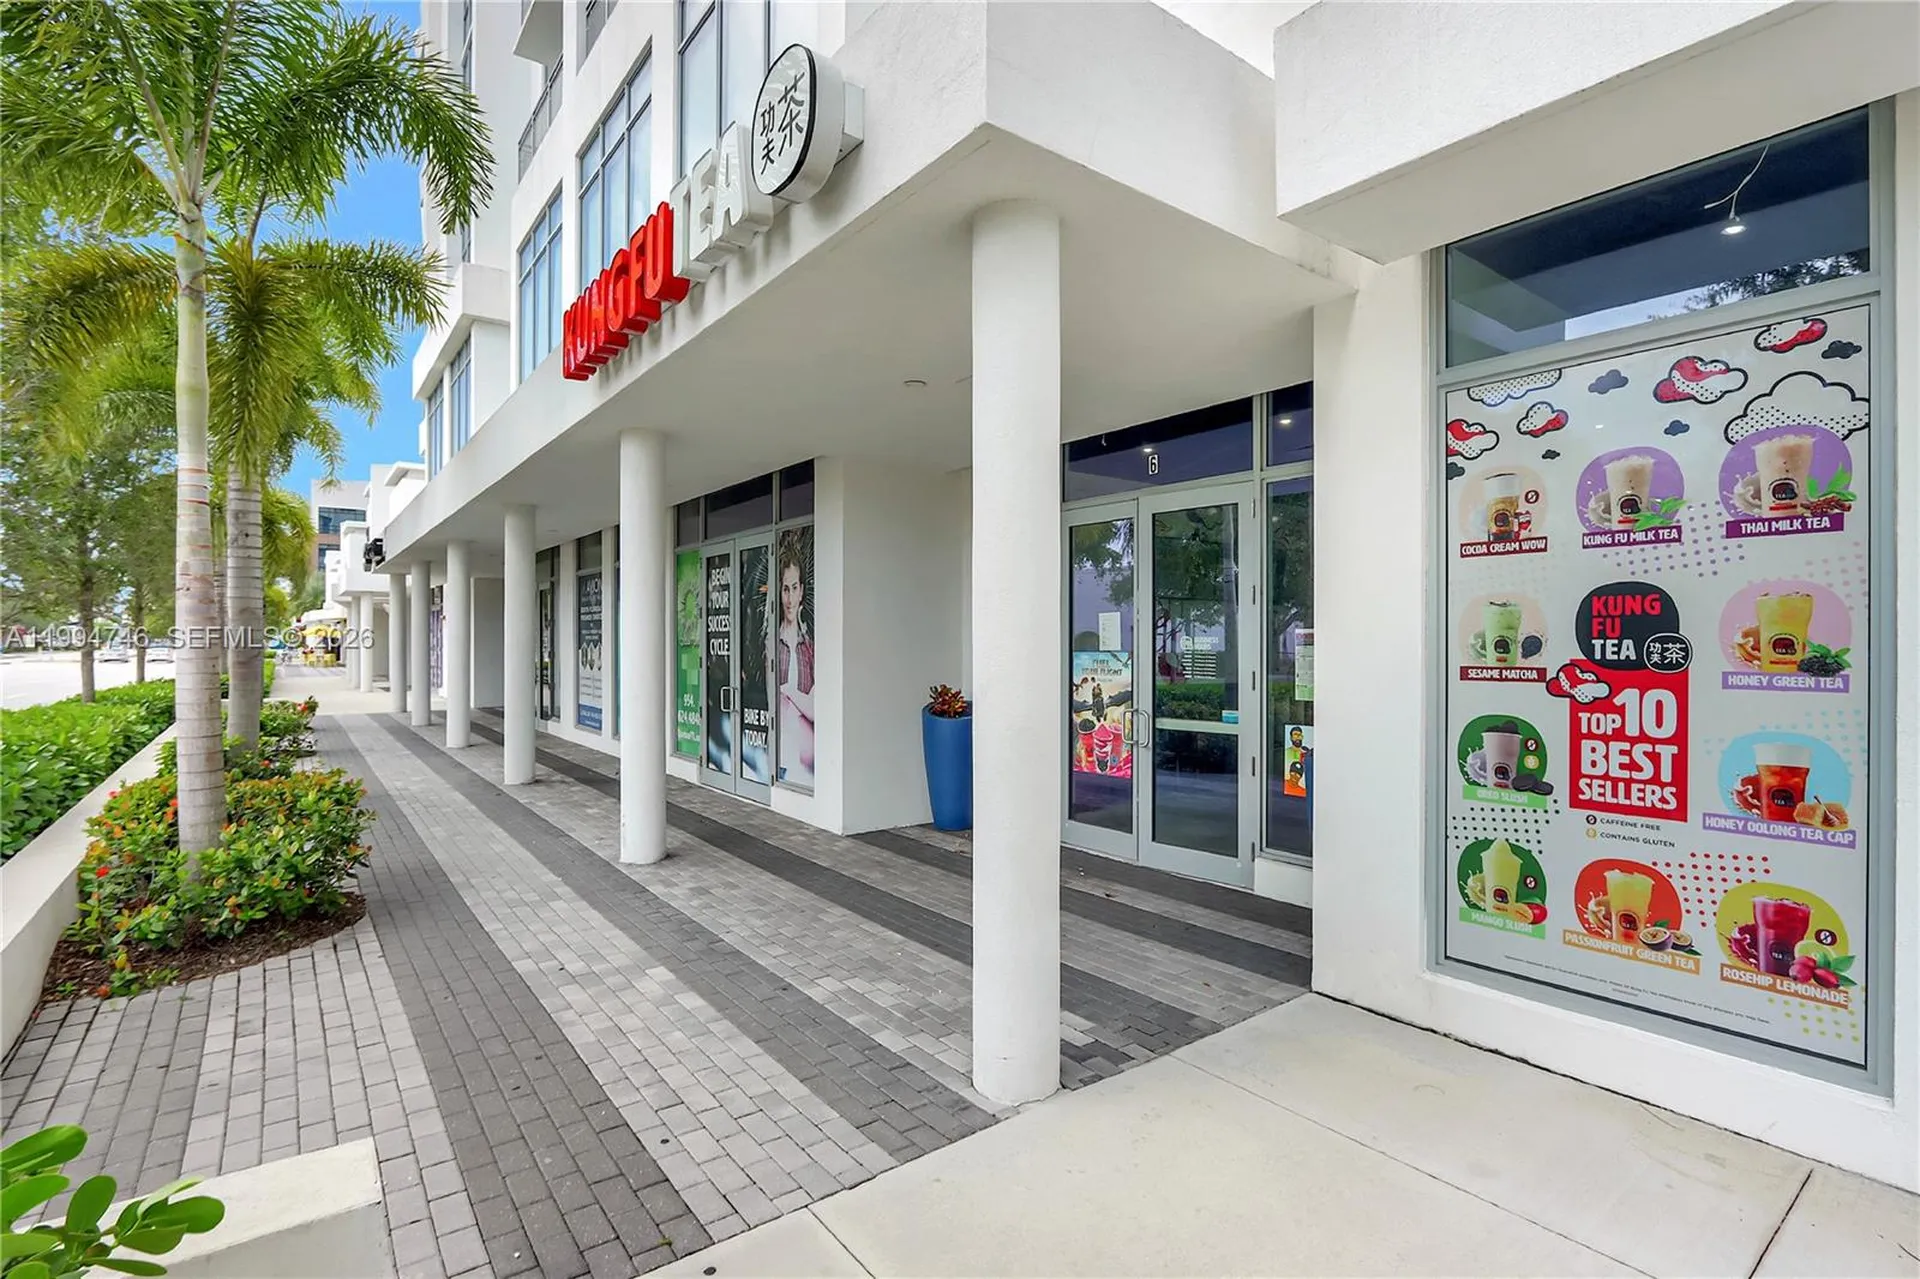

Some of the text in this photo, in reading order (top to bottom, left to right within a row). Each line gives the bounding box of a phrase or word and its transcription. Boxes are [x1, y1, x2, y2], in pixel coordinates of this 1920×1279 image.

[778, 71, 805, 157] 茶
[1150, 456, 1157, 473] 6
[1740, 517, 1831, 534] THAI MILK TEA
[1461, 539, 1546, 555] COCOA CREAM WOW
[1583, 529, 1678, 546] KUNG FU MILK TEA
[711, 591, 729, 609] YOUR
[1591, 594, 1662, 616] KUNG
[1591, 617, 1622, 638] FU
[1591, 639, 1637, 660] TEA
[1649, 642, 1686, 664] 功夫 茶
[1467, 668, 1538, 680] SESAME MATCHA
[1728, 674, 1844, 689] HONEY GREEN TEA
[1578, 688, 1678, 739] TOP 10
[1580, 739, 1679, 783] BEST
[1578, 777, 1678, 811] SELLERS
[1600, 817, 1661, 831] CAFFEINE FREE
[1705, 816, 1854, 845] HONEY OOLONG TEA CAP
[1600, 832, 1676, 848] CONTAINS GLUTEN
[1564, 932, 1696, 970] PASSIONFRUIT GREEN TEA
[1722, 967, 1849, 1005] ROSEHIP LEMONADE
